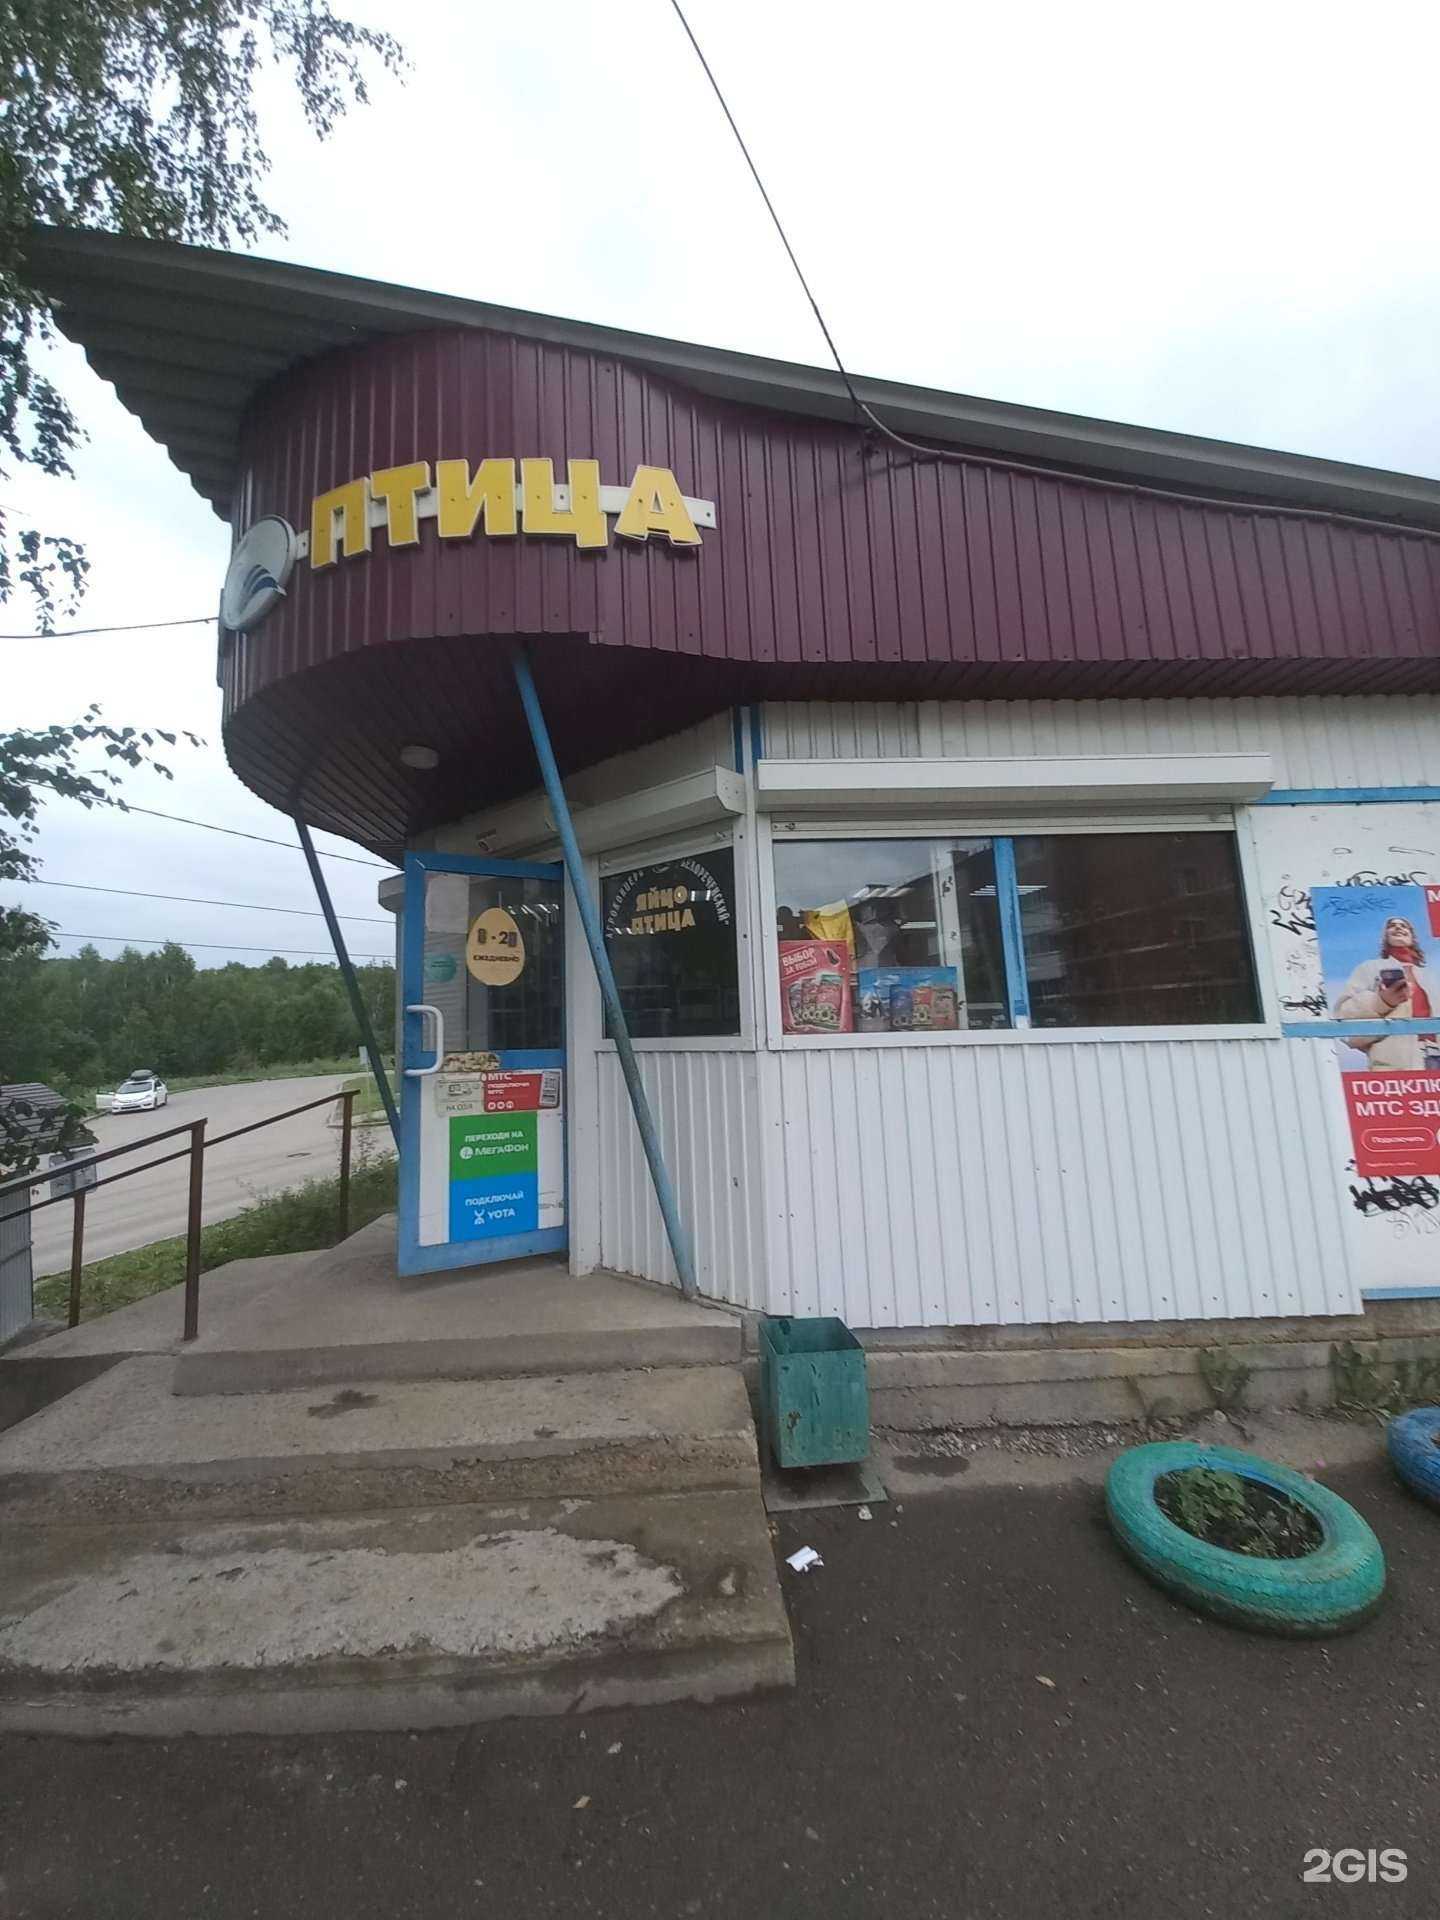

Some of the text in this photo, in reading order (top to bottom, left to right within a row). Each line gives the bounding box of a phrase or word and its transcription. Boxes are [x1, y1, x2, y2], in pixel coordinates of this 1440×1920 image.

[311, 457, 703, 569] ПТИЦА
[636, 885, 688, 912] ЯЙЦО
[1355, 1101, 1404, 1116] МТС
[475, 1143, 530, 1156] МЕГАФОН
[487, 1207, 516, 1219] YOTA
